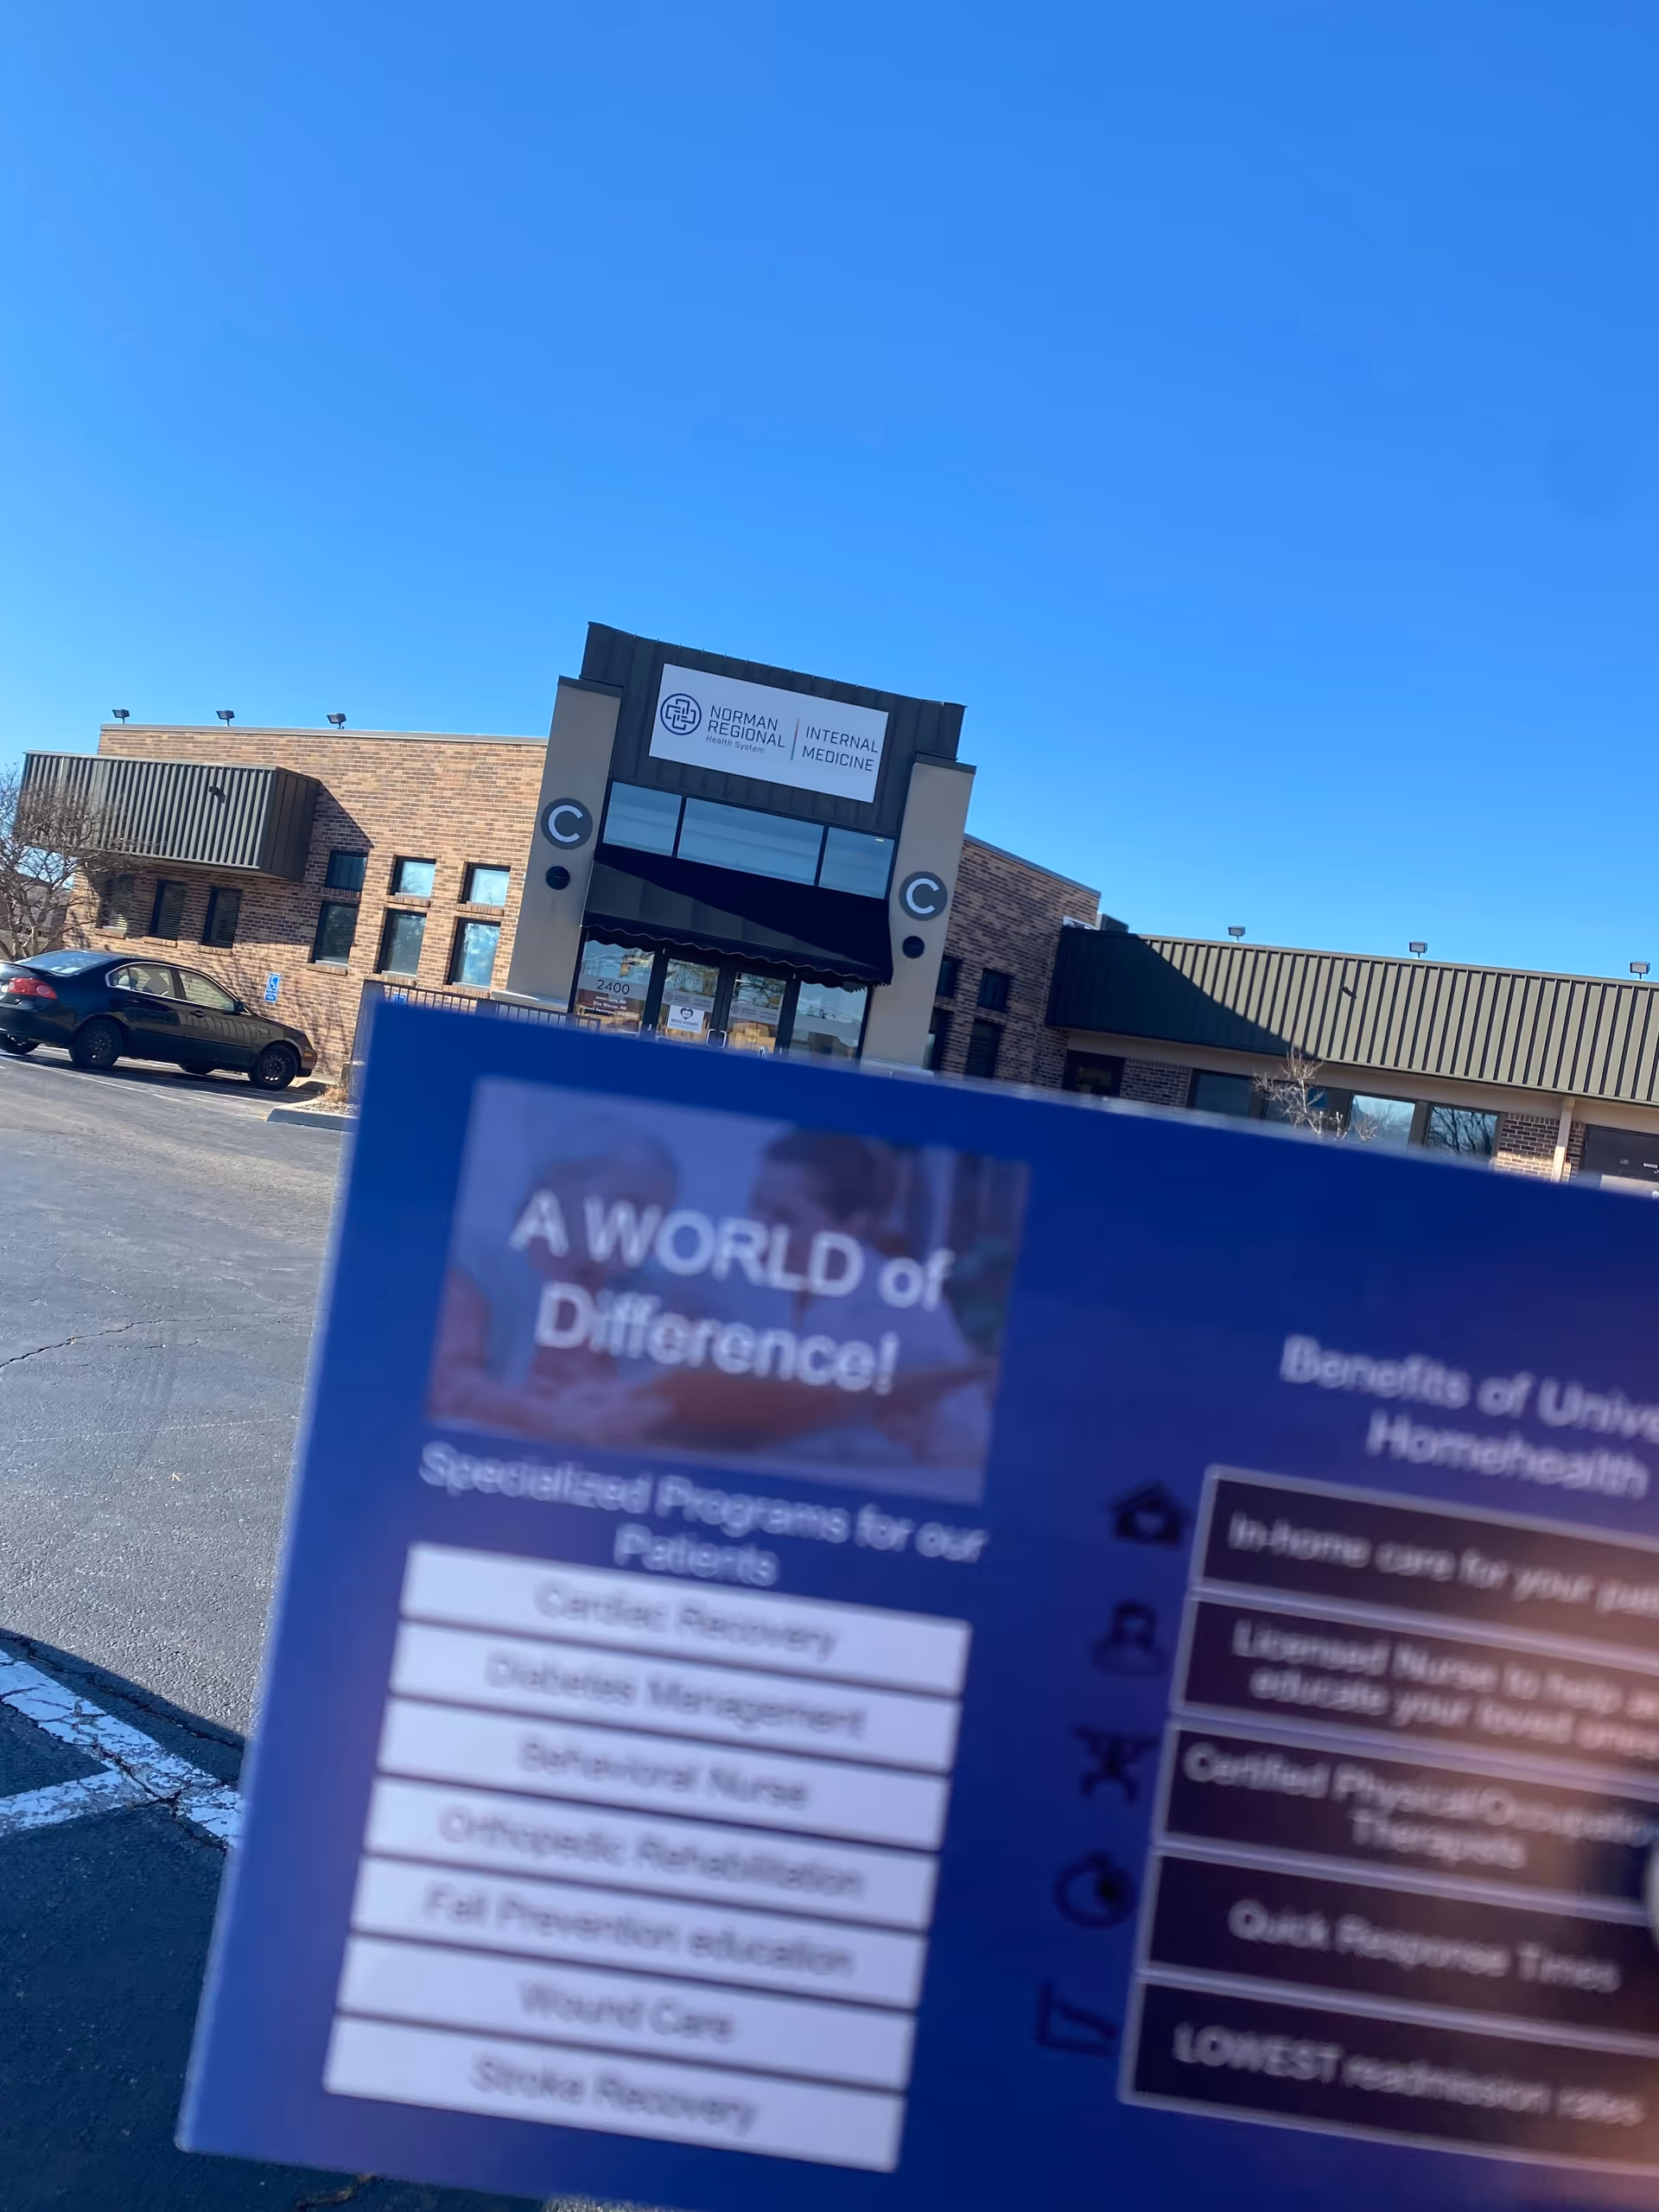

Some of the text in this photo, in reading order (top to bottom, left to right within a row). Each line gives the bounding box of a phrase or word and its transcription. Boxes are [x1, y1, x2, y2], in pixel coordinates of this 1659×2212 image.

[705, 734, 765, 754] Health System
[708, 720, 785, 748] REGIONAL
[710, 704, 779, 732] NORMAN
[805, 725, 879, 753] INTERNAL
[802, 745, 875, 772] MEDICINE
[549, 804, 583, 842] C
[906, 878, 940, 914] C
[596, 979, 630, 995] 2400
[510, 1190, 955, 1312] A WORLD of
[536, 1281, 900, 1396] Difference!
[1281, 1335, 1471, 1408] Benefits
[1477, 1370, 1535, 1419] of
[1367, 1410, 1649, 1499] Homehealth
[420, 1441, 988, 1562] Specialized Programs for our
[615, 1523, 779, 1586] Patients
[1228, 1510, 1371, 1568] In-home
[1375, 1541, 1456, 1582] care
[1459, 1547, 1510, 1589] for
[1512, 1566, 1595, 1604] your
[534, 1580, 838, 1662] Cardiac Recovery
[485, 1649, 867, 1738] Diabetes Management
[1233, 1618, 1390, 1675] Licensed
[1392, 1641, 1498, 1694] Nurse
[1502, 1662, 1541, 1700] to
[1542, 1671, 1623, 1715] help
[1249, 1668, 1389, 1717] educate
[1390, 1690, 1469, 1728] your
[1474, 1699, 1576, 1744] loved
[520, 1734, 808, 1809] Behavioral Nurse
[1185, 1741, 1330, 1799] Certified
[438, 1805, 865, 1899] Orthopedic Rehabilitation
[1351, 1808, 1528, 1870] Therapists
[424, 1880, 856, 1977] Fall Prevention education
[1228, 1899, 1621, 1994] Quick Response Times
[520, 1982, 736, 2044] Wound Care
[470, 2053, 759, 2138] Stroke Recovery
[1173, 2023, 1343, 2084] LOWEST
[1555, 2086, 1644, 2127] rates
